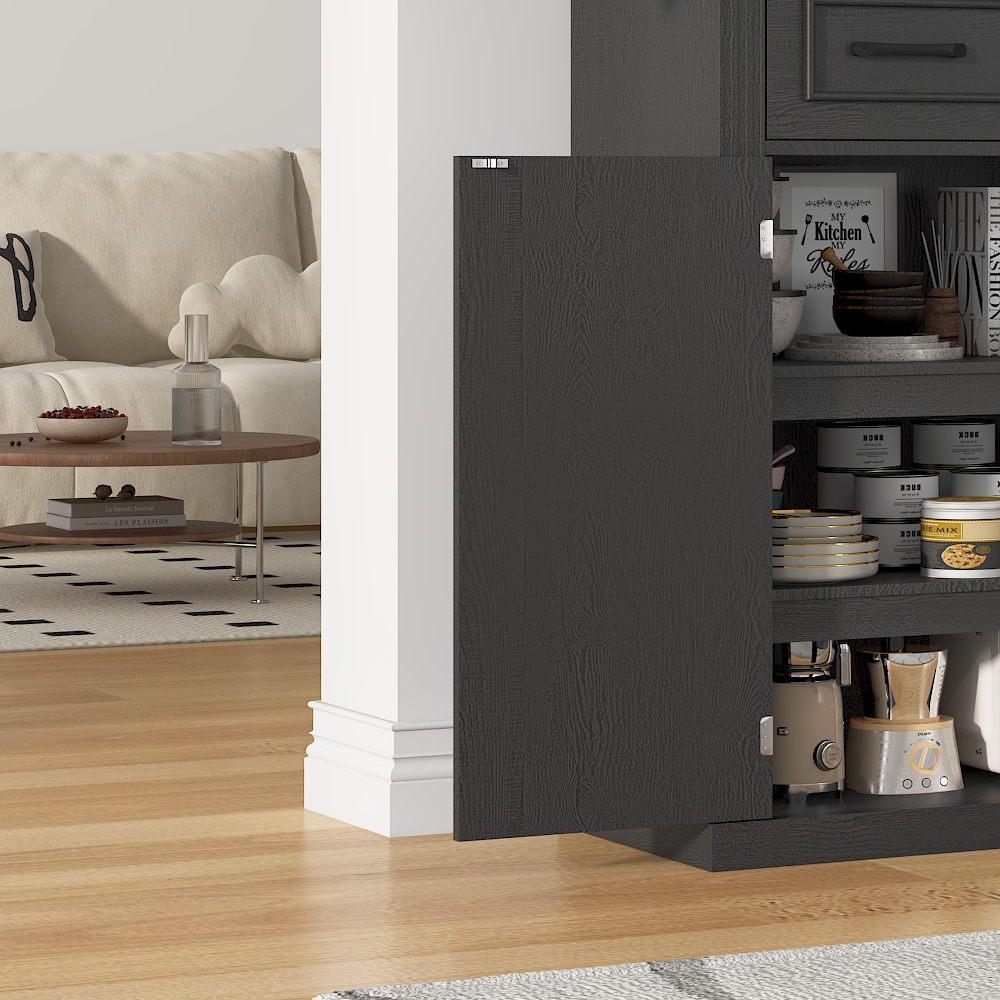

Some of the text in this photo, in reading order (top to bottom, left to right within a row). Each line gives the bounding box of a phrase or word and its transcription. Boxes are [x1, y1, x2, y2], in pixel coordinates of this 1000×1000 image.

[830, 213, 846, 221] MY
[938, 190, 985, 252] THE
[814, 221, 862, 241] Kitchen
[831, 241, 846, 249] MY
[988, 237, 1000, 321] FASHION
[989, 326, 1000, 356] BO
[132, 518, 169, 526] PLAISIRS
